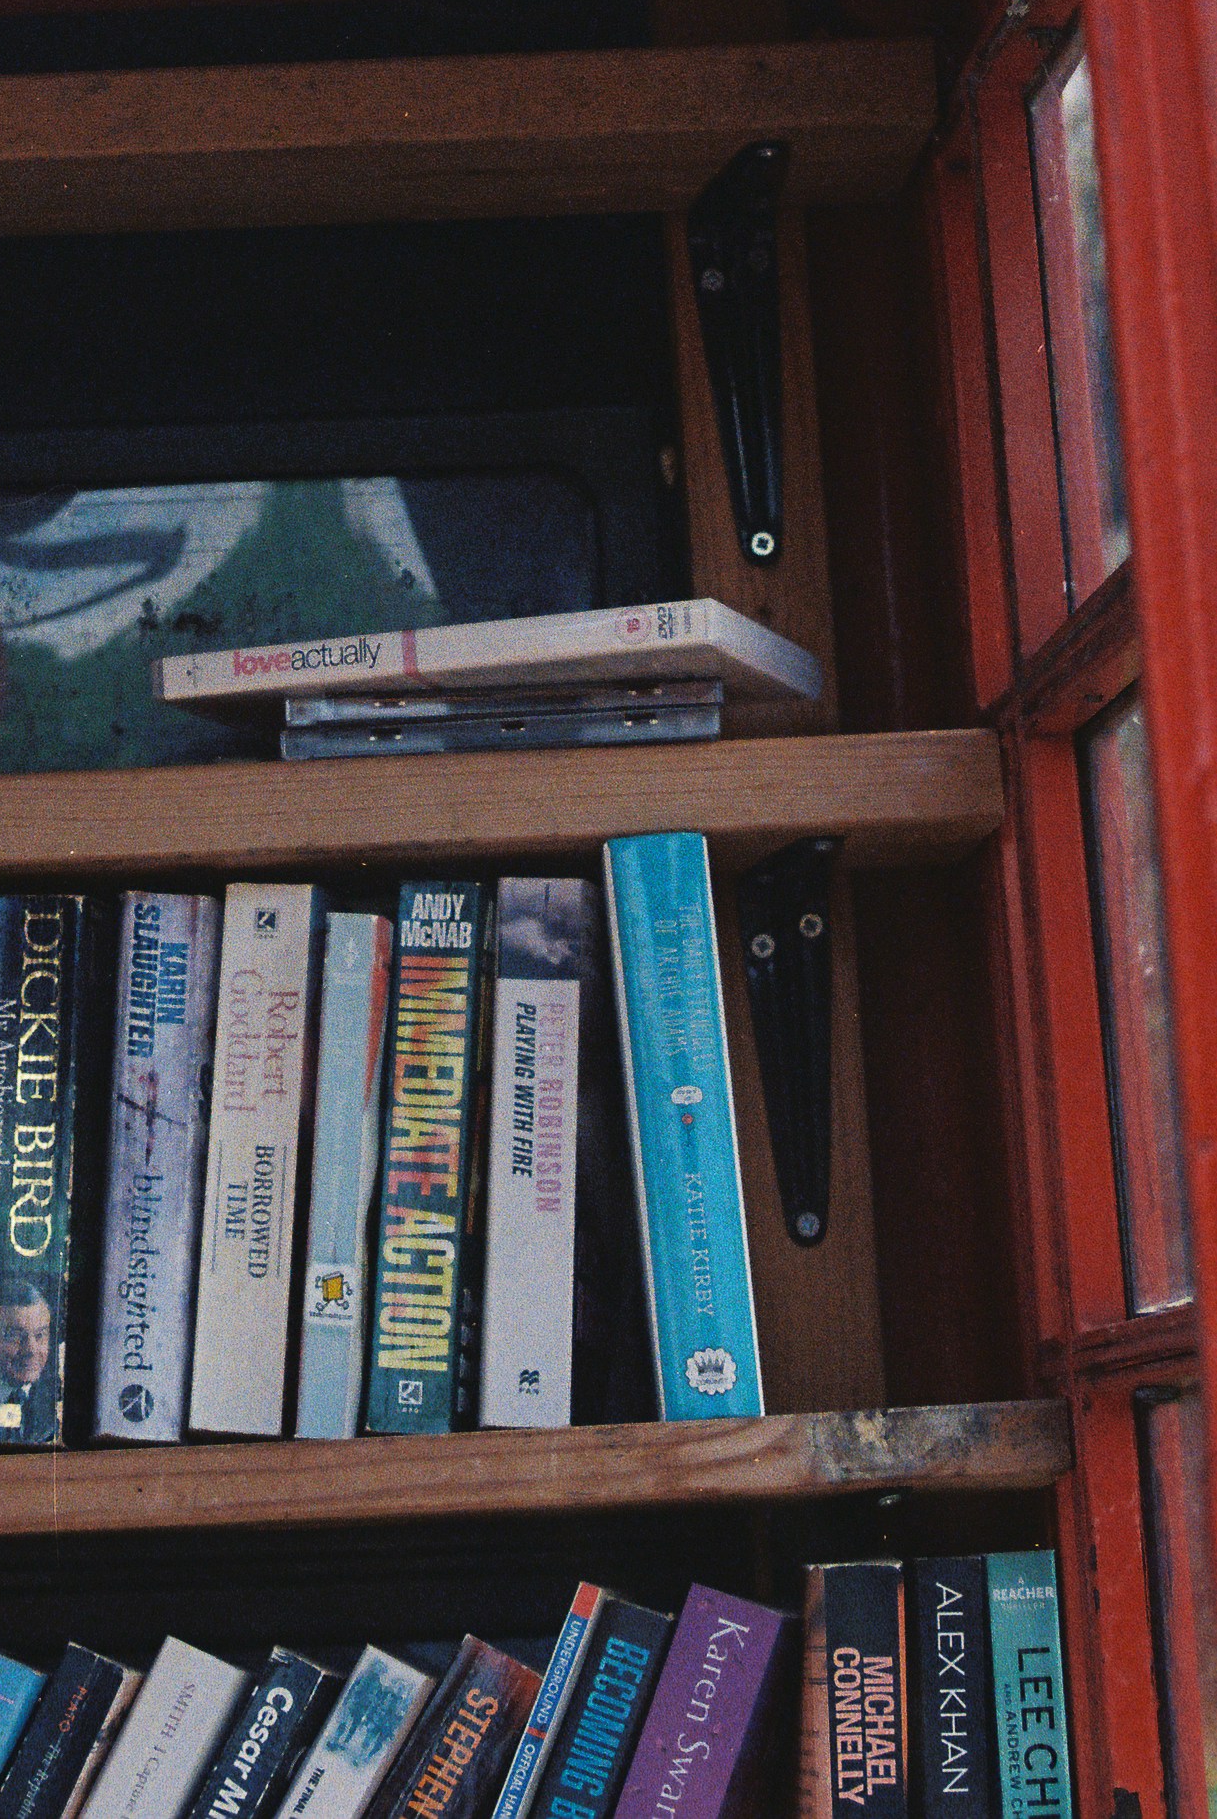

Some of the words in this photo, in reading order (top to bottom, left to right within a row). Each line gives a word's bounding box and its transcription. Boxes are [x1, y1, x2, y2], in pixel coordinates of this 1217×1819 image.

[400, 920, 472, 950] McNAB
[412, 893, 465, 923] ANDY
[654, 919, 678, 935] OF
[679, 903, 702, 930] THE
[13, 908, 64, 1105] DICKIE
[126, 902, 160, 1057] SLAUGHTER
[155, 942, 190, 1025] KARIN
[656, 947, 684, 1001] ARCHIE
[221, 966, 263, 1114] Goddard
[259, 989, 300, 1101] Robert
[515, 1002, 536, 1082] PLAYING
[538, 1002, 565, 1073] PETER
[662, 1010, 688, 1056] ADAMS
[686, 987, 716, 1072] STRUGGLES
[387, 955, 470, 1197] IMMEDIATE
[513, 1085, 535, 1134] WITH
[512, 1137, 535, 1176] FIRE
[536, 1078, 564, 1214] ROBINSON
[9, 1123, 57, 1258] BIRD
[223, 1181, 248, 1241] TIME
[246, 1144, 276, 1279] BORROWED
[683, 1172, 707, 1243] KATIE
[118, 1173, 164, 1372] blindsighted
[378, 1205, 457, 1372] ACTION
[691, 1249, 715, 1318] KIRBY
[935, 1581, 966, 1677] ALEX
[991, 1586, 1055, 1602] REACHER
[58, 1684, 89, 1734] PLATO
[535, 1619, 583, 1726] UNDERGROUND
[685, 1616, 751, 1723] Karen
[1016, 1645, 1057, 1733] LEE
[159, 1682, 196, 1740] SMITH
[232, 1685, 294, 1780] Cesar
[559, 1636, 651, 1798] BECOMING
[832, 1646, 866, 1807] CONNELLY
[862, 1655, 898, 1797] MICHAEL
[938, 1688, 970, 1794] KHAN
[1004, 1710, 1024, 1791] ANDREW
[45, 1742, 64, 1768] The
[123, 1755, 160, 1817] Capture
[310, 1766, 326, 1785] THE
[405, 1687, 499, 1819] STEPHEN
[514, 1742, 537, 1789] OFFICIAL
[1023, 1743, 1063, 1819] CH
[292, 1782, 318, 1815] FINAL
[499, 1788, 519, 1819] HAN
